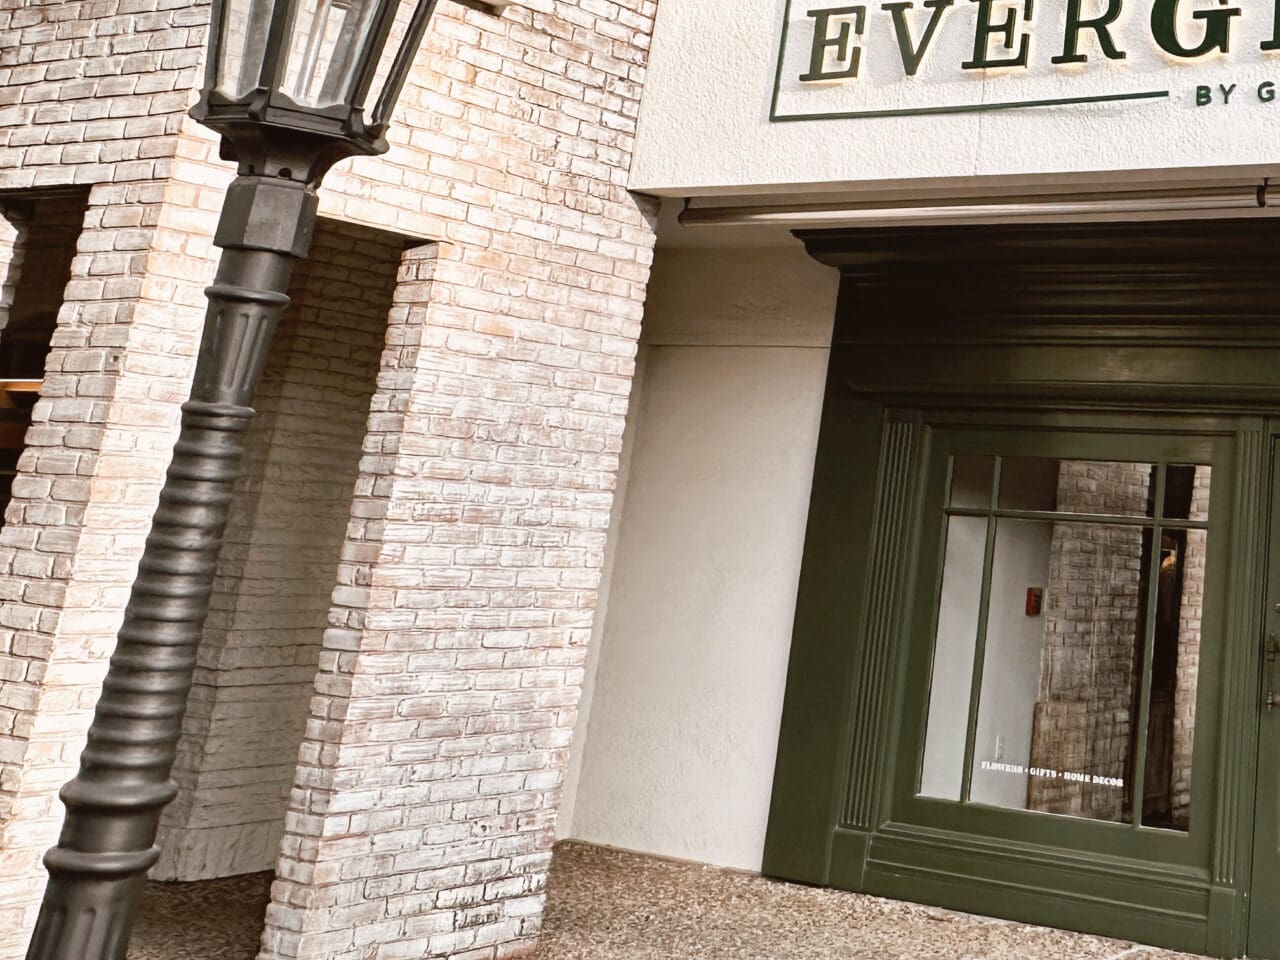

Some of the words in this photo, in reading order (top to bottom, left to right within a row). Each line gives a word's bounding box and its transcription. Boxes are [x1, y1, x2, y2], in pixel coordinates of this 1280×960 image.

[1195, 85, 1235, 108] BY
[981, 761, 1023, 774] FLOWERS
[1030, 768, 1057, 778] GIFTS
[1063, 772, 1091, 783] HOME
[1092, 775, 1124, 787] DECOR
